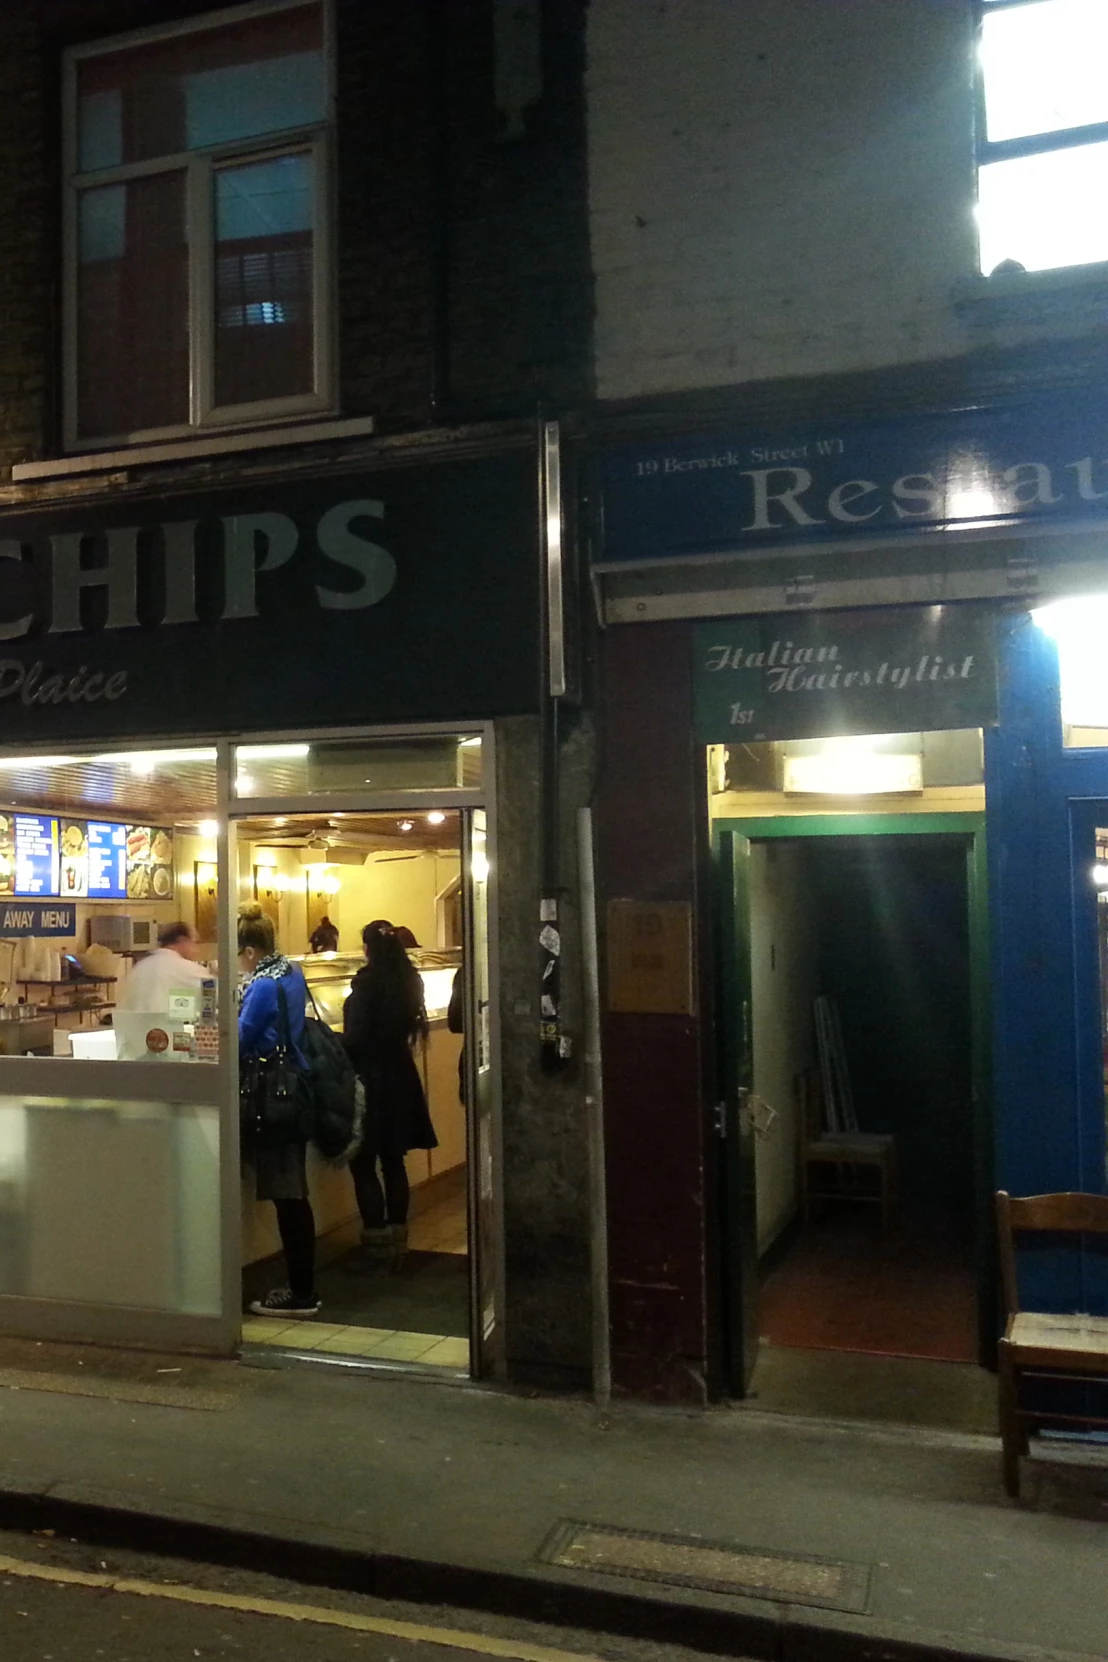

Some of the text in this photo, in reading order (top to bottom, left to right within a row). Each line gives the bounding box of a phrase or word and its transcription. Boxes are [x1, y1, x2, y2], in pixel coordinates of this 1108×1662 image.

[636, 439, 845, 476] 19 Berwick Street W1
[704, 640, 840, 672] Italian
[767, 655, 976, 693] Hairstylist
[4, 910, 35, 929] AWAY
[41, 910, 70, 929] MENU
